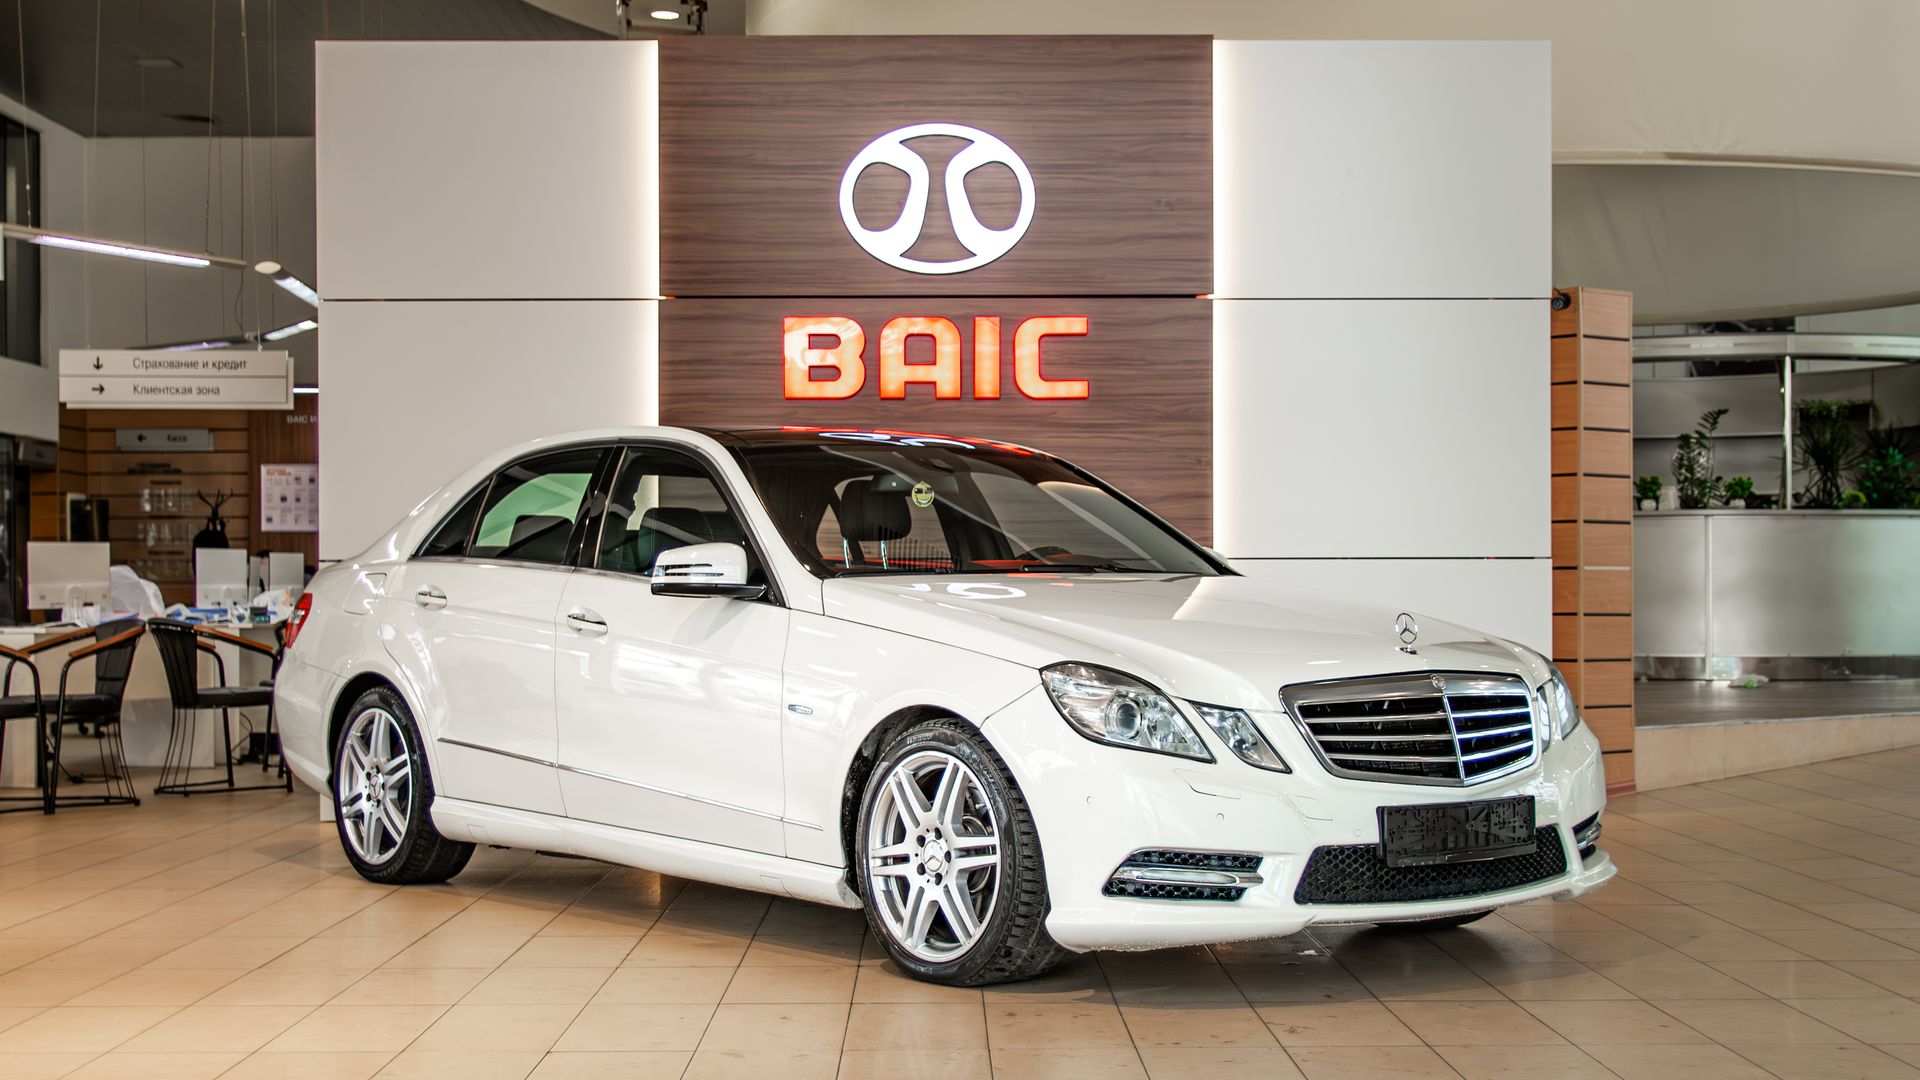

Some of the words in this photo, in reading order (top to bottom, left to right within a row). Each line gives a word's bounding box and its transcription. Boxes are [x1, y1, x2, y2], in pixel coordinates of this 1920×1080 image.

[132, 357, 199, 371] Страхование
[202, 360, 209, 369] и
[212, 360, 247, 371] кредит
[783, 315, 1090, 400] BAIC
[132, 383, 193, 395] Клиентская
[196, 386, 220, 395] зона
